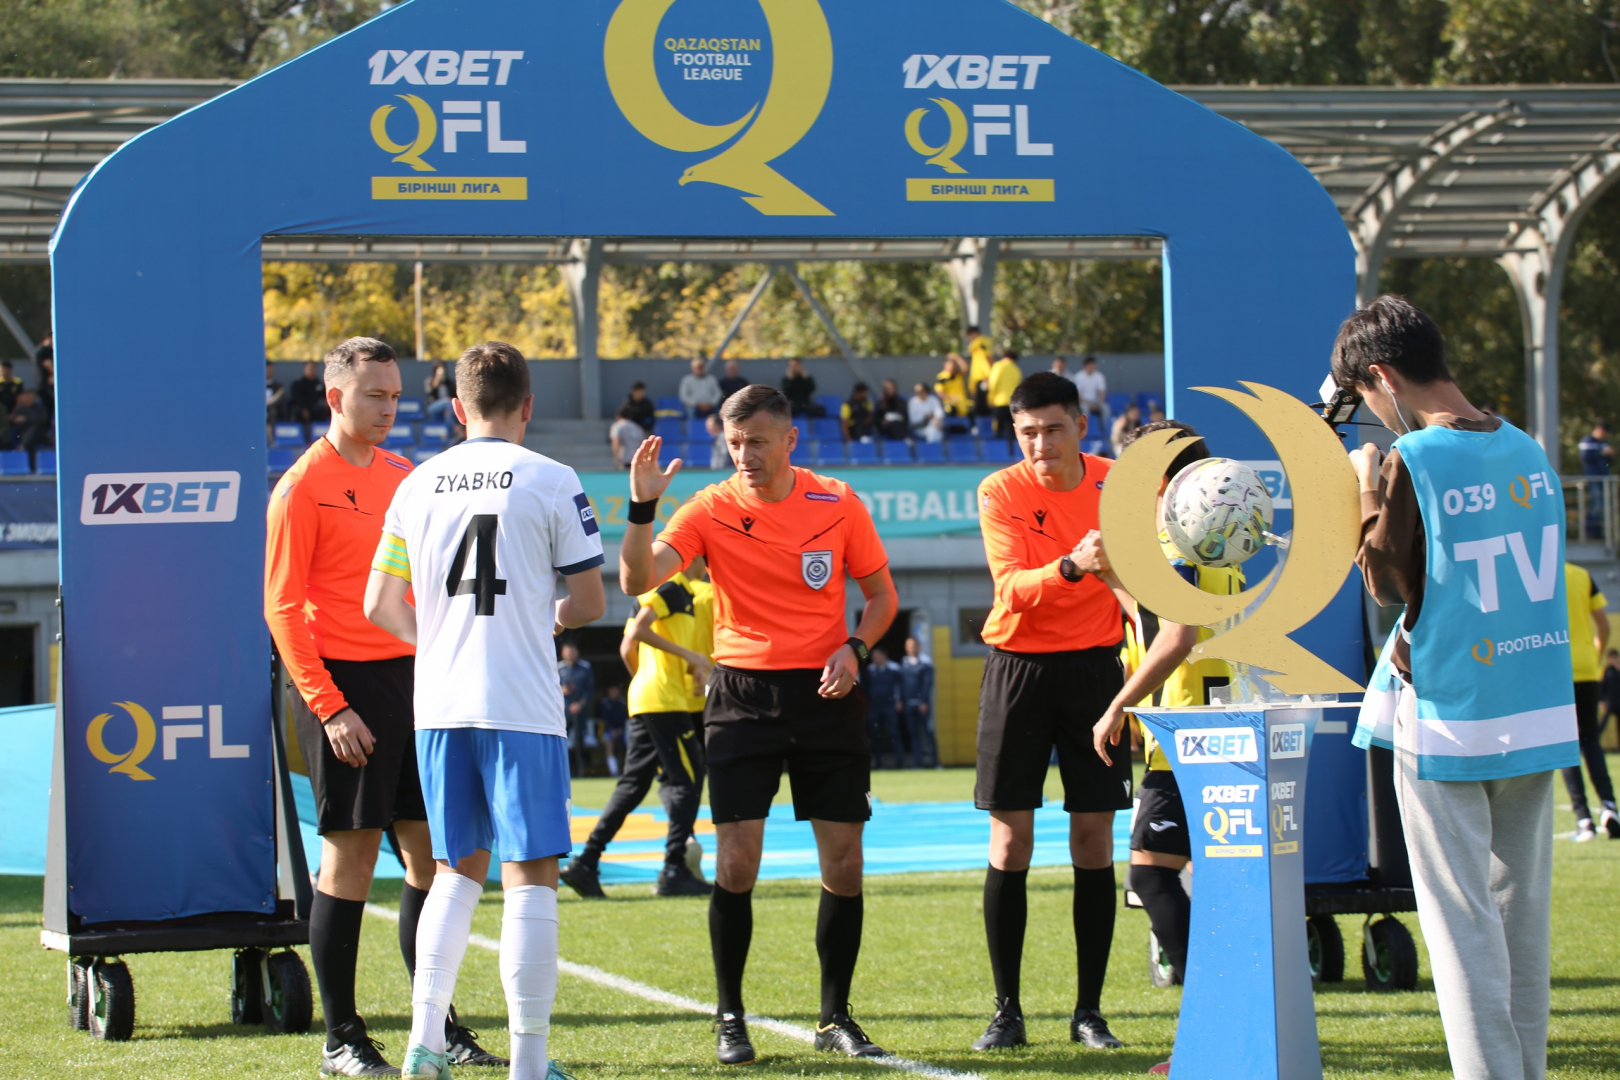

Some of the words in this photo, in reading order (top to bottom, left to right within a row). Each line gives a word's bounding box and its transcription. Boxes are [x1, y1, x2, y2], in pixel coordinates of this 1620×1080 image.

[664, 38, 761, 52] QAZAQSTAN
[673, 53, 752, 66] FOOTBALL
[368, 50, 525, 85] 1XBET
[683, 68, 743, 81] LEAGUE
[902, 54, 1051, 90] 1XBET
[370, 93, 527, 172] QFL
[904, 97, 1054, 174] QFL
[397, 183, 456, 193] БІРІНШІ
[461, 183, 501, 193] ЛИГА
[931, 185, 987, 195] БІРІНШІ
[991, 185, 1030, 195] ЛИГА
[434, 471, 513, 493] ZYABKO
[91, 481, 231, 515] 1XBET
[857, 489, 979, 521] TBALL
[1443, 483, 1496, 516] 039
[446, 514, 507, 616] 4
[1453, 524, 1559, 613] TV
[1497, 629, 1570, 656] FOOTBALL
[86, 701, 250, 780] QFL
[1182, 734, 1251, 757] 1XBET
[1272, 730, 1303, 753] 1XBET
[1202, 784, 1260, 804] 1XBET
[1271, 781, 1296, 800] 1XBET
[1203, 806, 1263, 844] QFL
